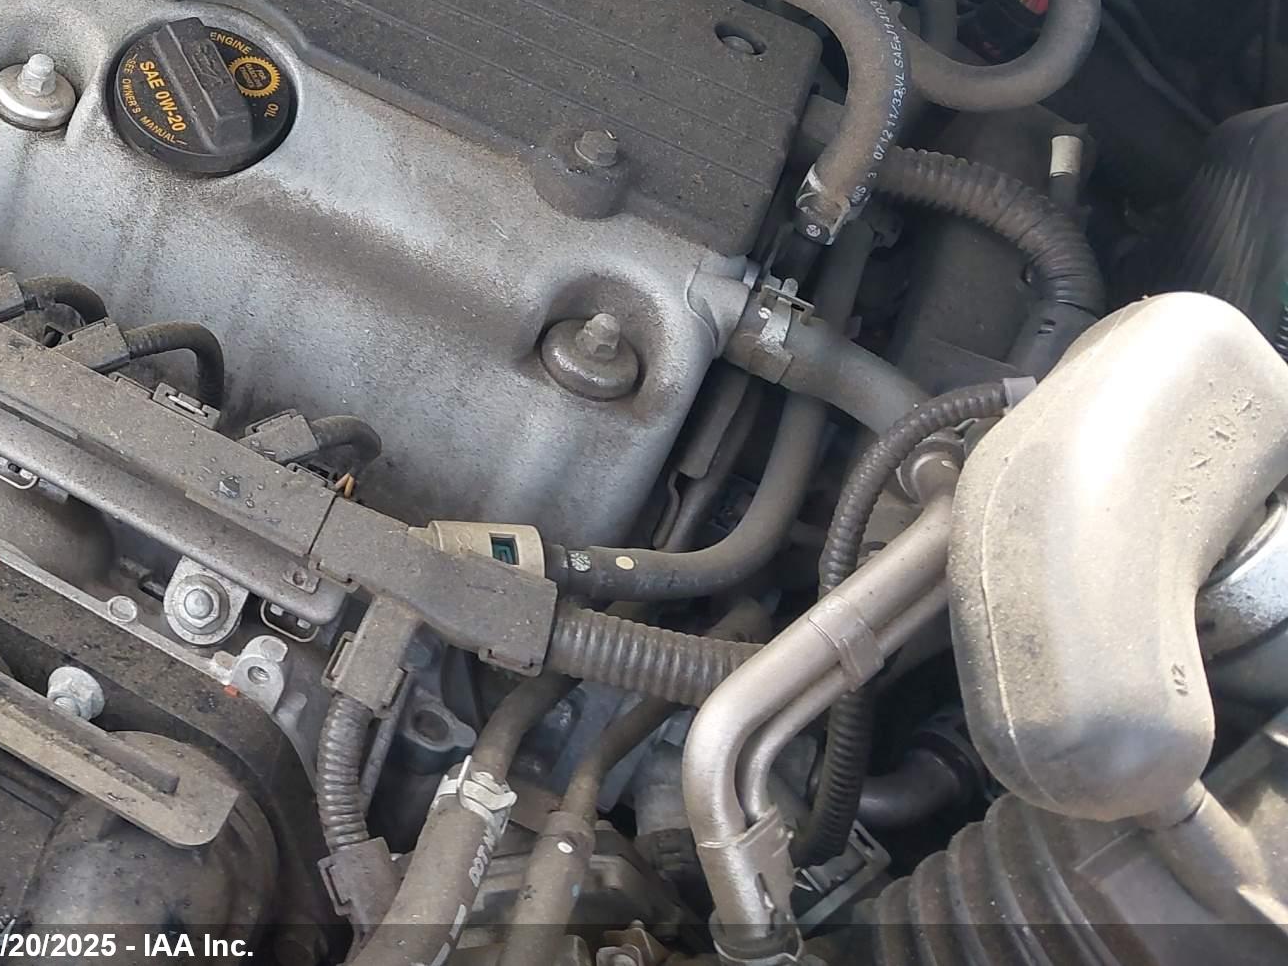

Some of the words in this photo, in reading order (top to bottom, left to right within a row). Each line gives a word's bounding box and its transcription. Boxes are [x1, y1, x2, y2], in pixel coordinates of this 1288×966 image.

[210, 30, 253, 55] ENGINE
[895, 71, 906, 90] VL
[139, 60, 165, 90] SAE
[155, 90, 188, 132] 0W-20
[122, 77, 142, 115] OWNER'S
[139, 115, 177, 144] MANUAL
[264, 101, 280, 119] OIL
[886, 87, 904, 128] 11/32
[882, 129, 894, 145] 12
[873, 143, 887, 161] 07
